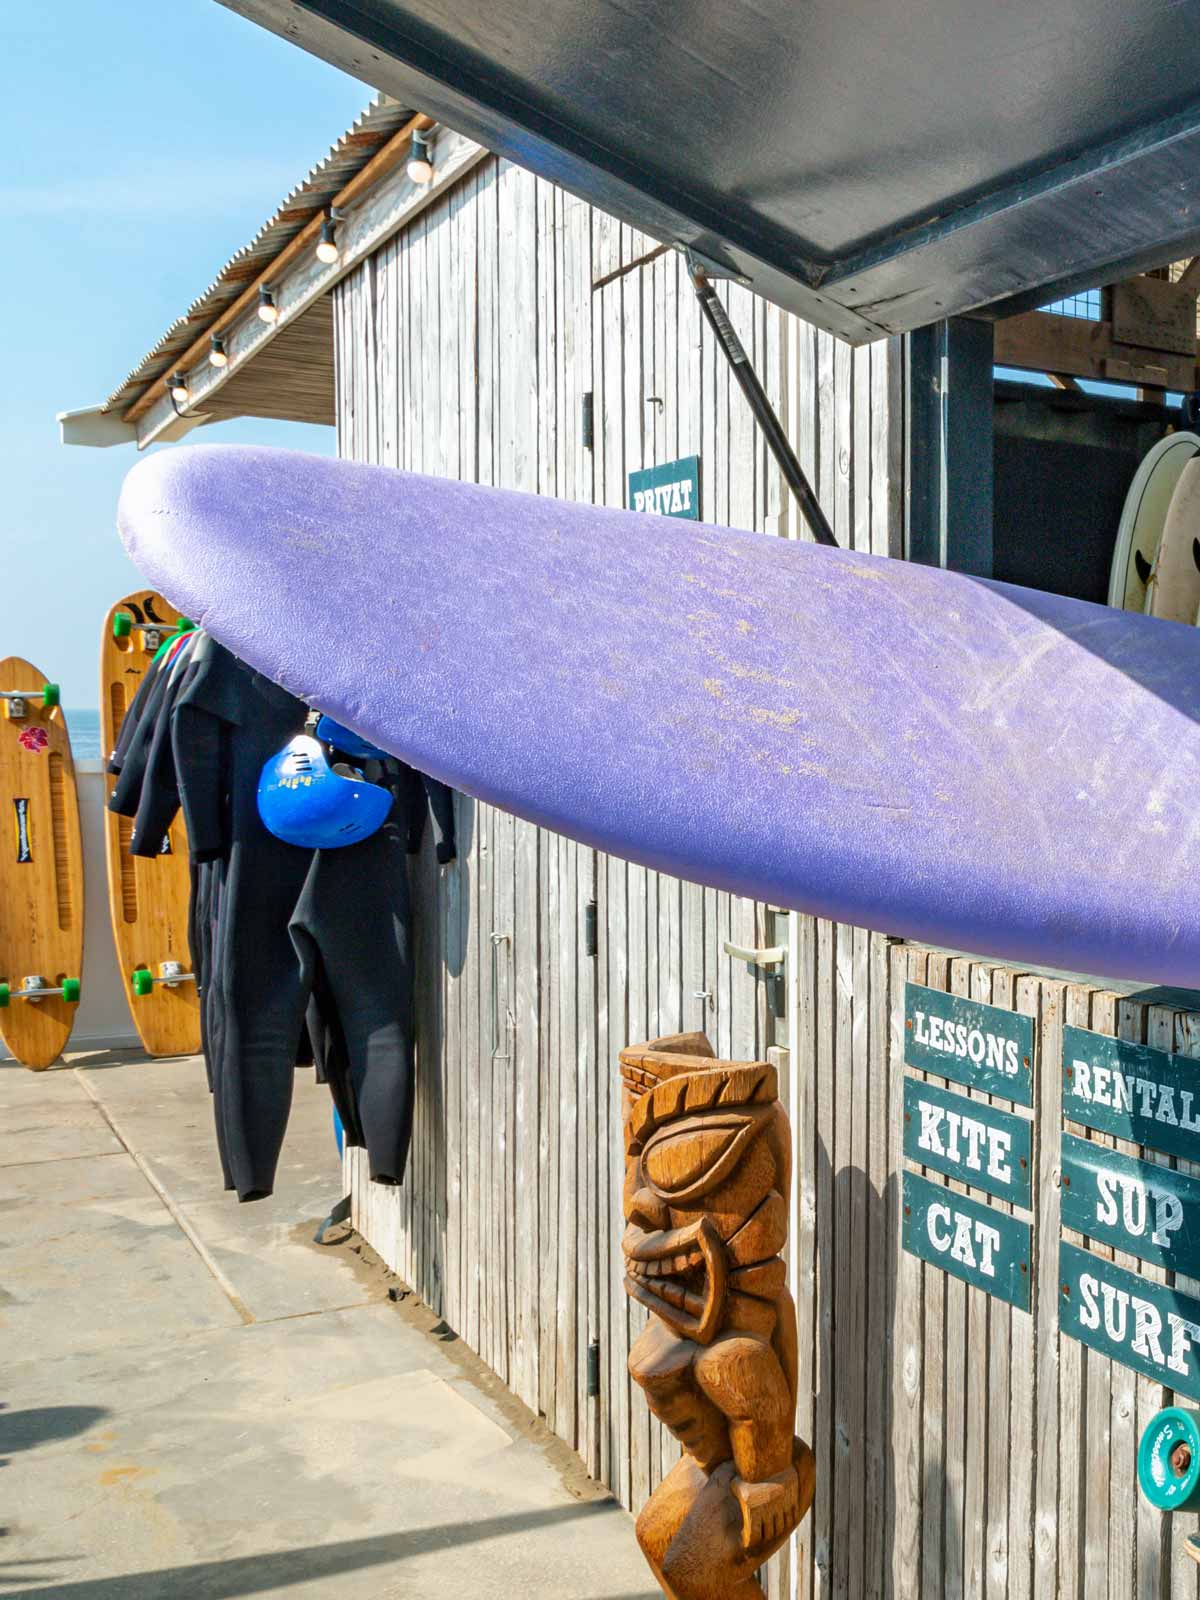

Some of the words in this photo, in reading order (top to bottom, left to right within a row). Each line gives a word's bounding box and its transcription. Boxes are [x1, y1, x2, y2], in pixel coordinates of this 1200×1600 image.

[913, 1010, 1019, 1077] LESSONS
[917, 1100, 1012, 1185] KITE
[926, 1202, 1001, 1278] CAT
[1096, 1167, 1184, 1249] SUP
